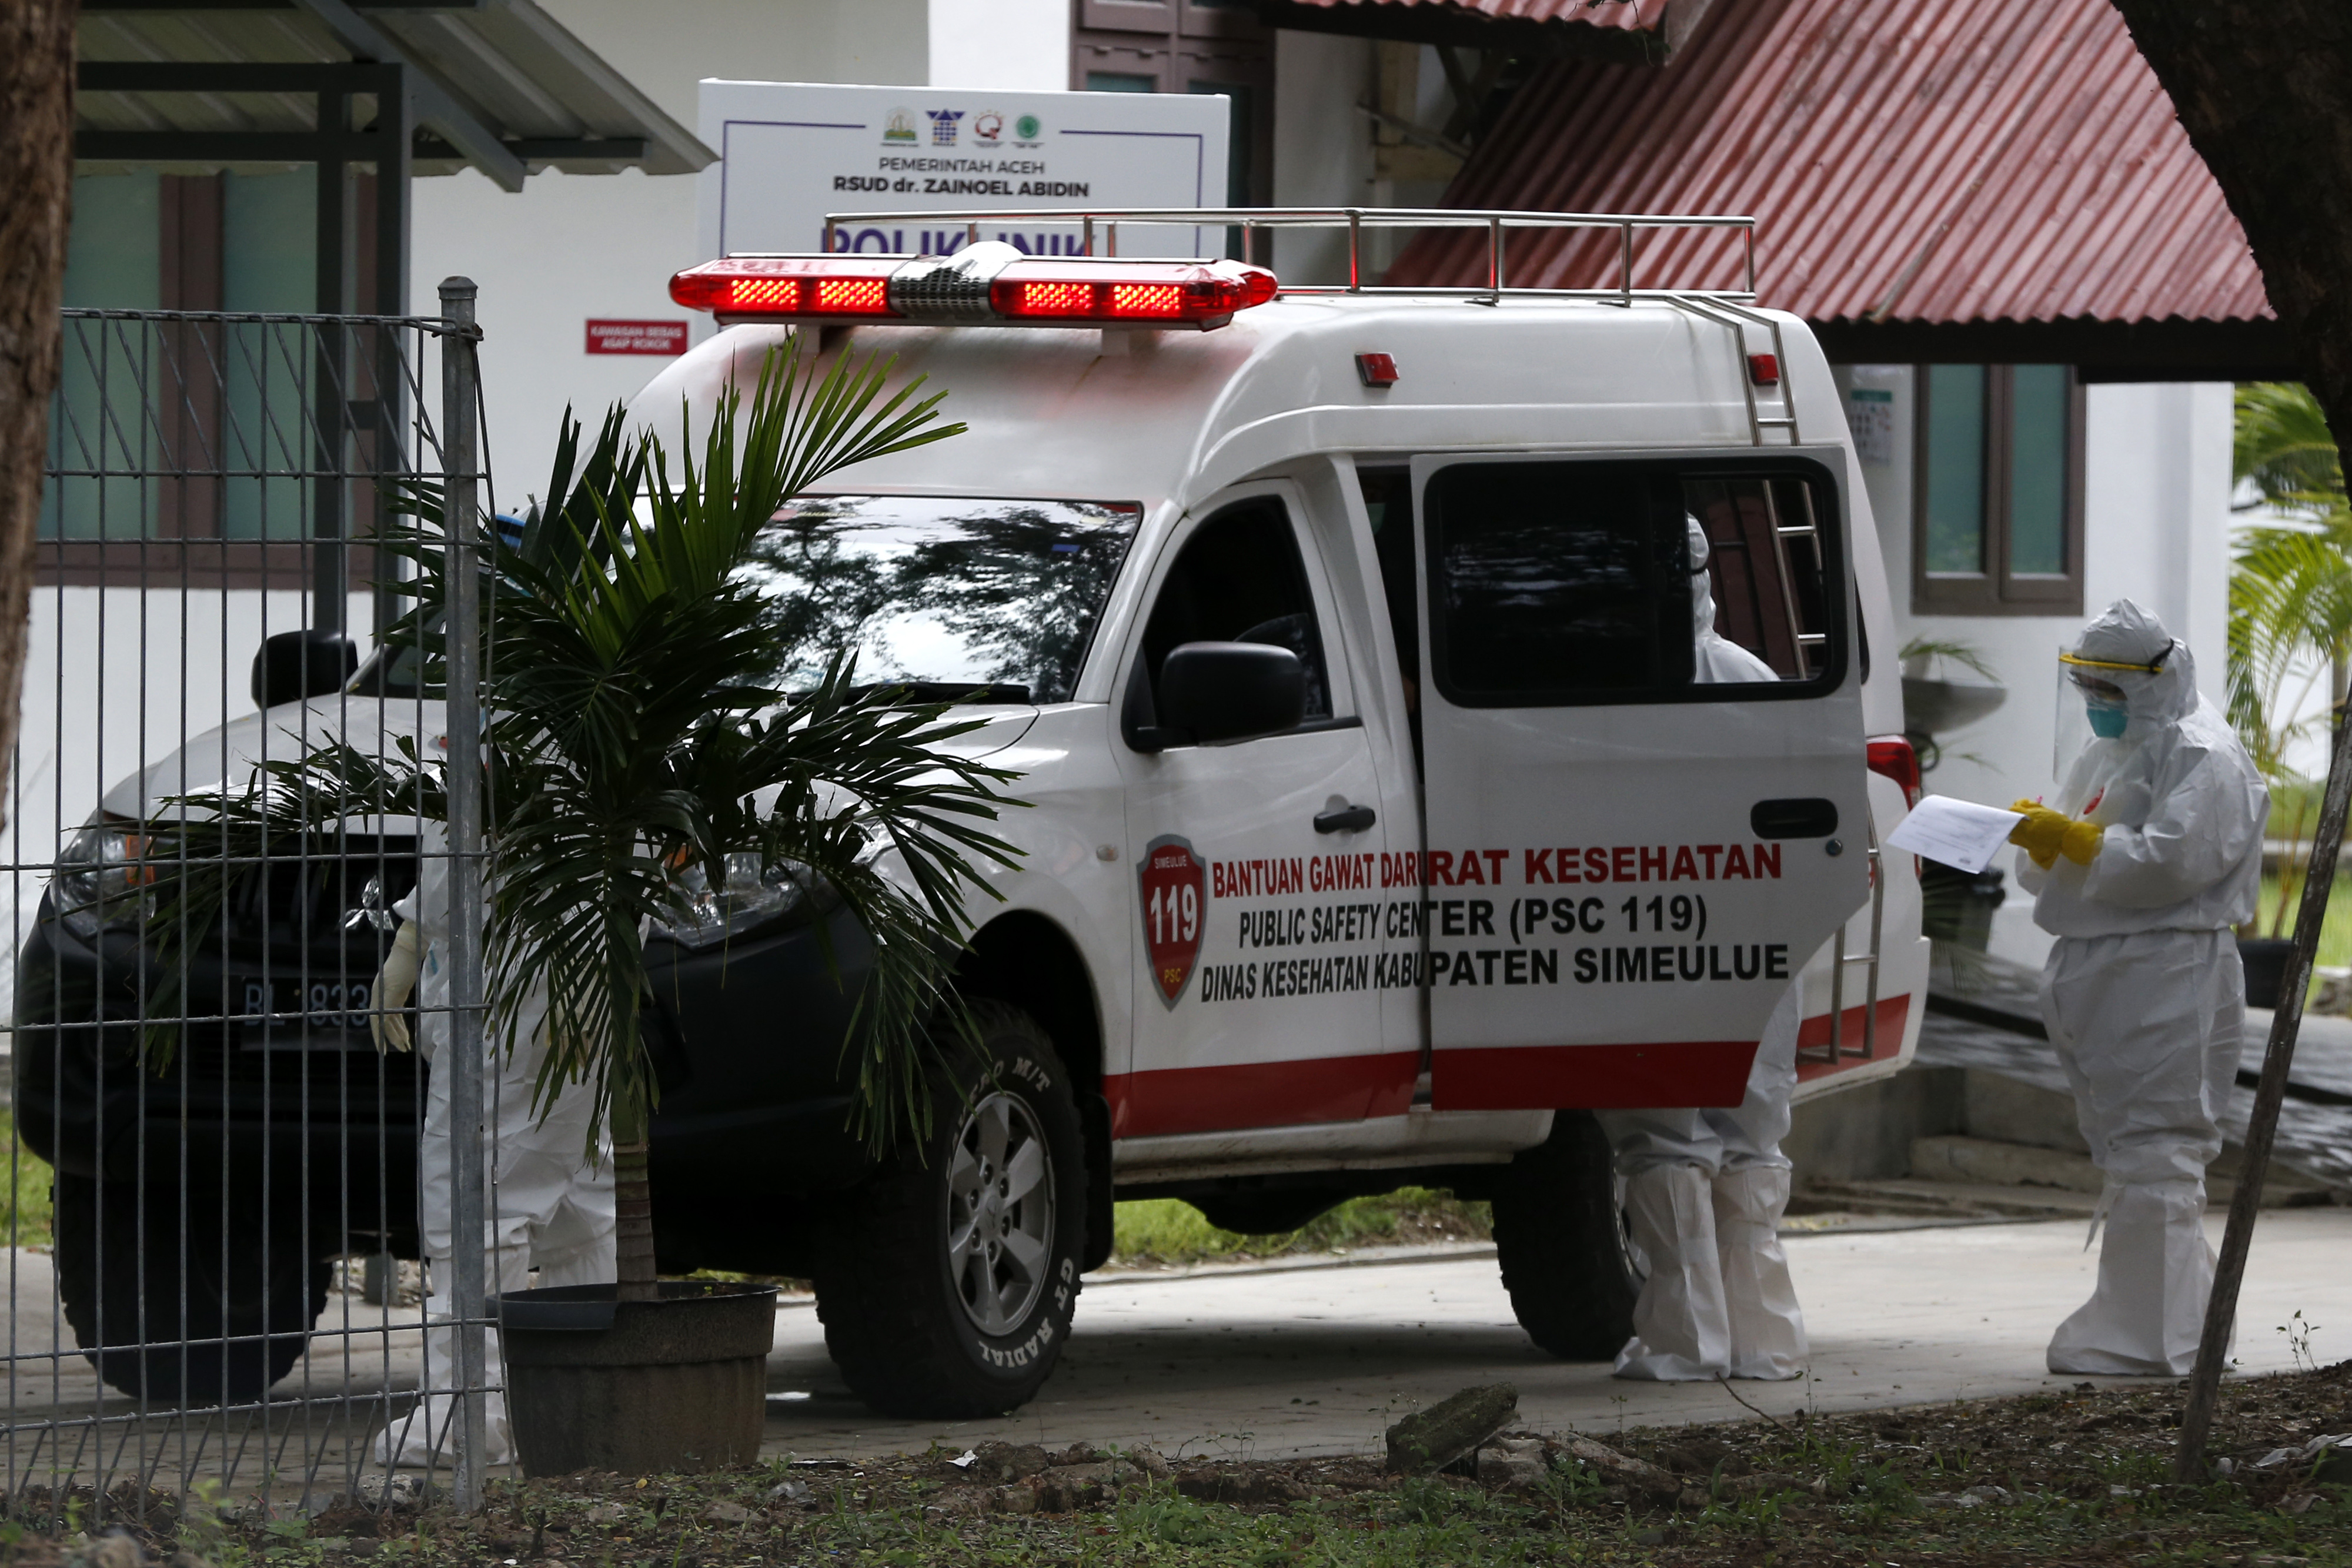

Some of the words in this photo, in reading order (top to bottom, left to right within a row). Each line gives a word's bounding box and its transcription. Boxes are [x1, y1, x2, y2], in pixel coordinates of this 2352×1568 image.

[834, 176, 888, 192] RSUD
[894, 178, 919, 193] dr.
[924, 179, 1013, 196] ZAINOEL
[1018, 182, 1090, 197] ABIDIN
[879, 157, 992, 173] PEMERINTAH
[997, 161, 1045, 175] ACEH
[1155, 855, 1187, 869] SIMEULUE
[1212, 858, 1302, 898] BANTUAN
[1309, 854, 1374, 892] GAWAT
[1525, 844, 1782, 884] KESEHATAN
[1150, 884, 1197, 944] 119
[1240, 908, 1305, 948] PUBLIC
[1311, 904, 1381, 943] SAFETY
[1386, 900, 1495, 938] CENTER
[1509, 897, 1605, 944] (PSC
[1621, 894, 1707, 941] 119)
[1164, 968, 1181, 983] PSC
[1201, 963, 1256, 1002] DINAS
[1262, 955, 1368, 998] KESEHATAN
[1374, 948, 1558, 989] KABUPATEN
[1573, 944, 1789, 984] SIMEULUE
[978, 1317, 1053, 1368] RADIAL
